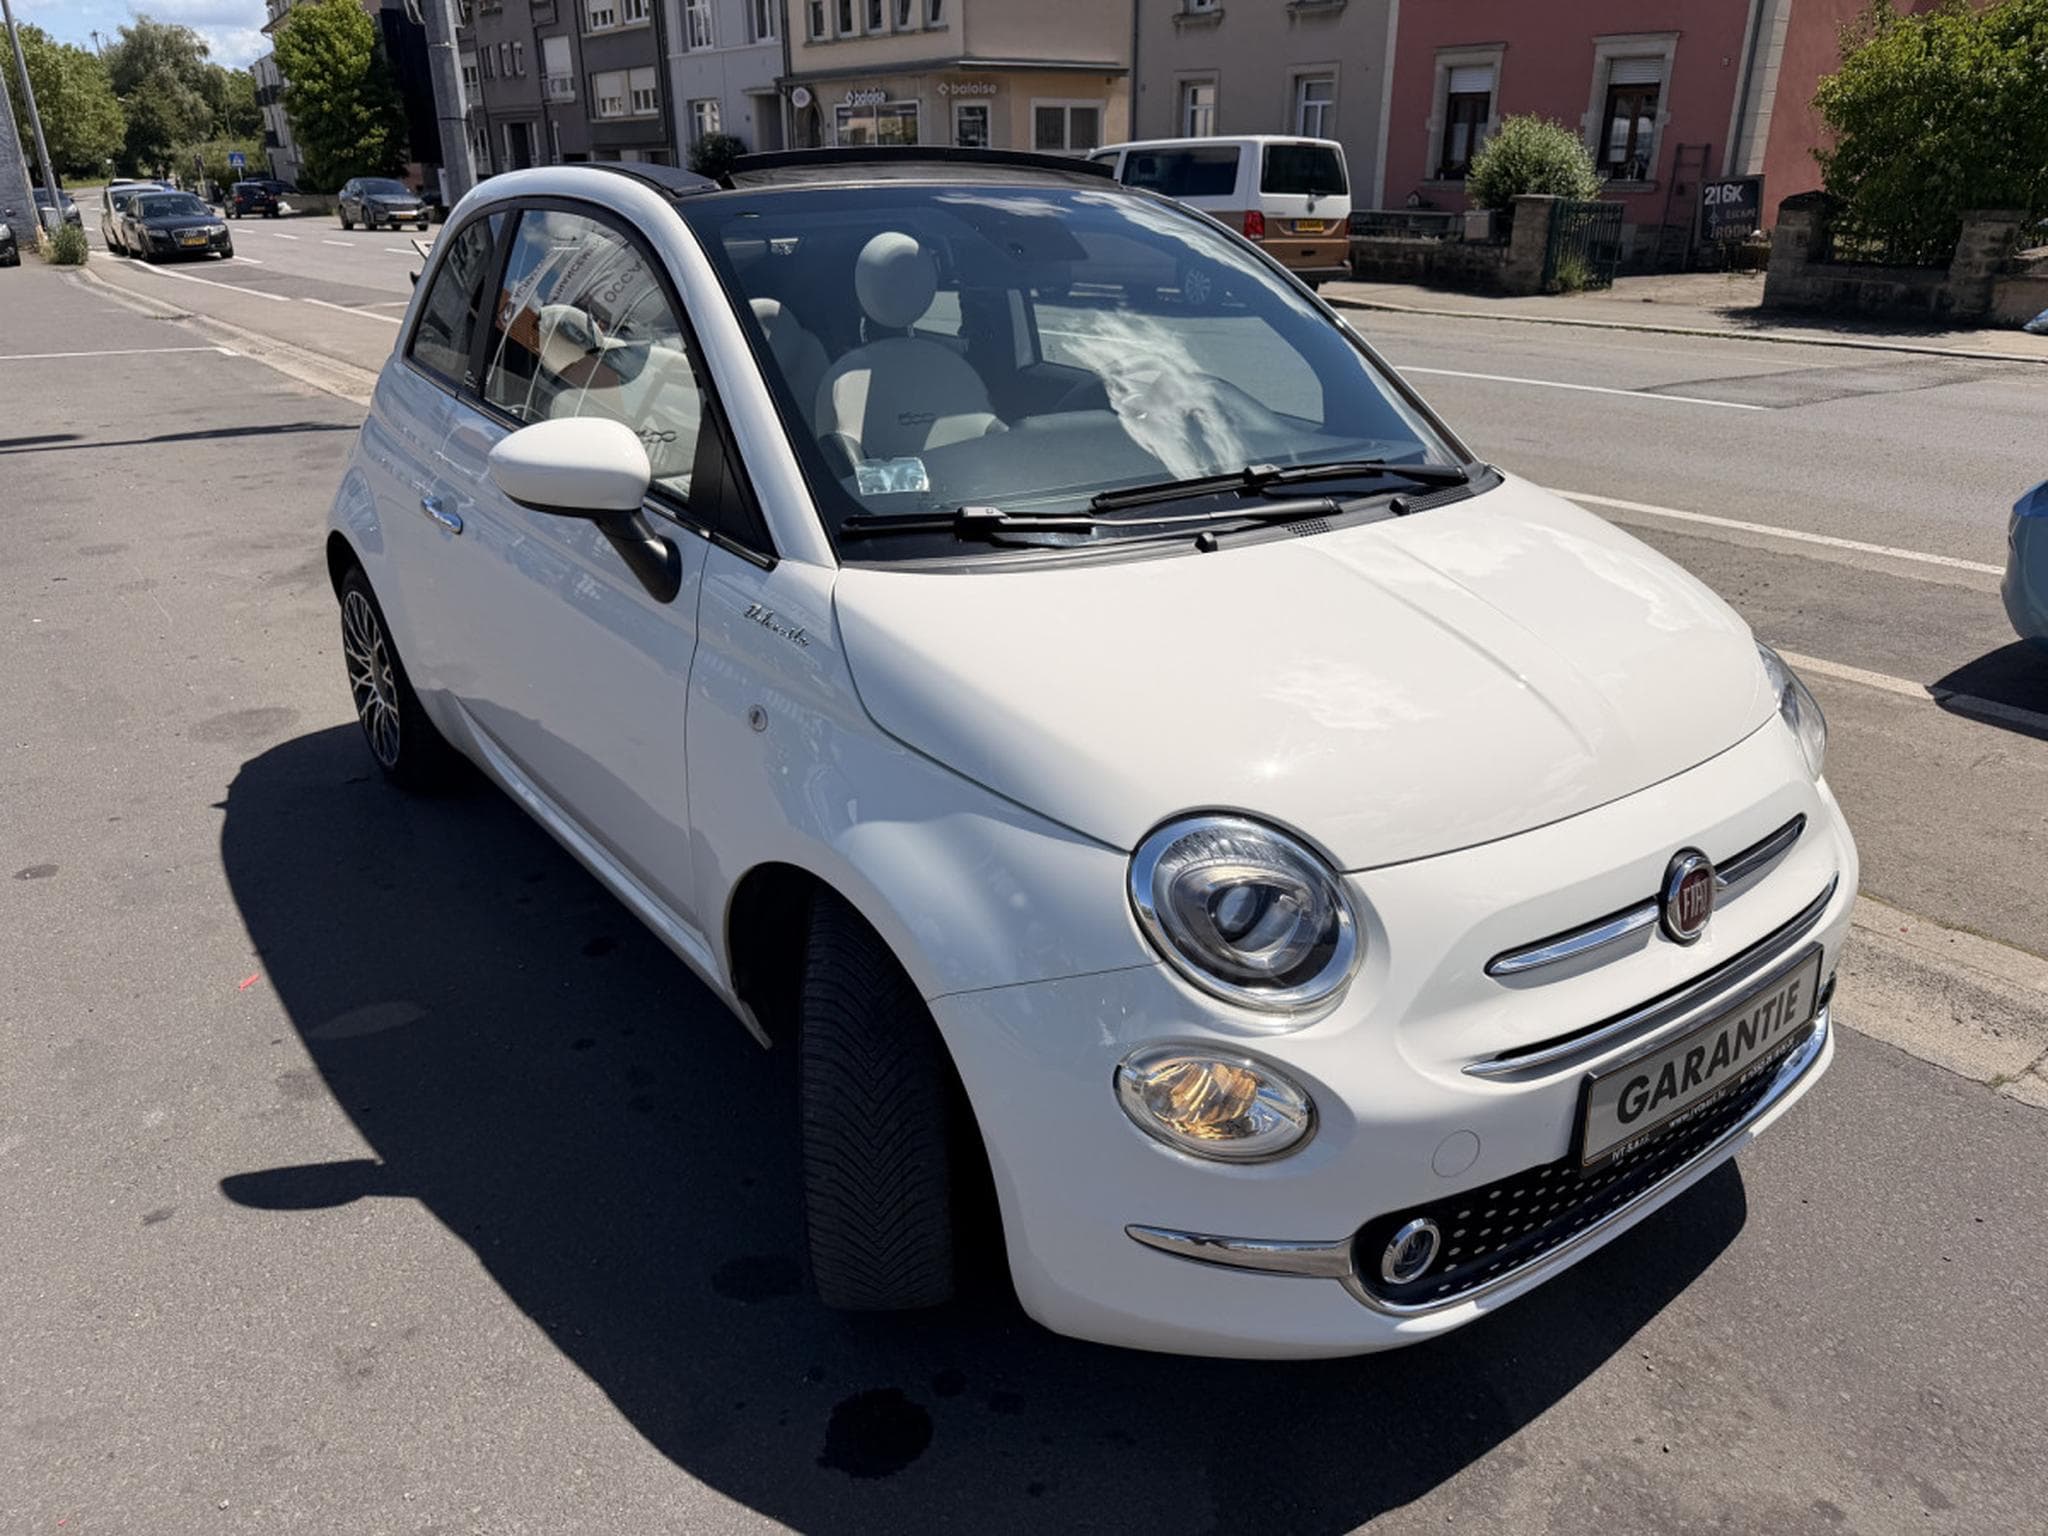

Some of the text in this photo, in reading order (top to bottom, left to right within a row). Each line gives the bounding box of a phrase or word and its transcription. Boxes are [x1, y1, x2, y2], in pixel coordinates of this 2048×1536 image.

[951, 82, 998, 95] baloise
[1683, 877, 1709, 921] FIAT
[1616, 980, 1799, 1124] GARANTIE
